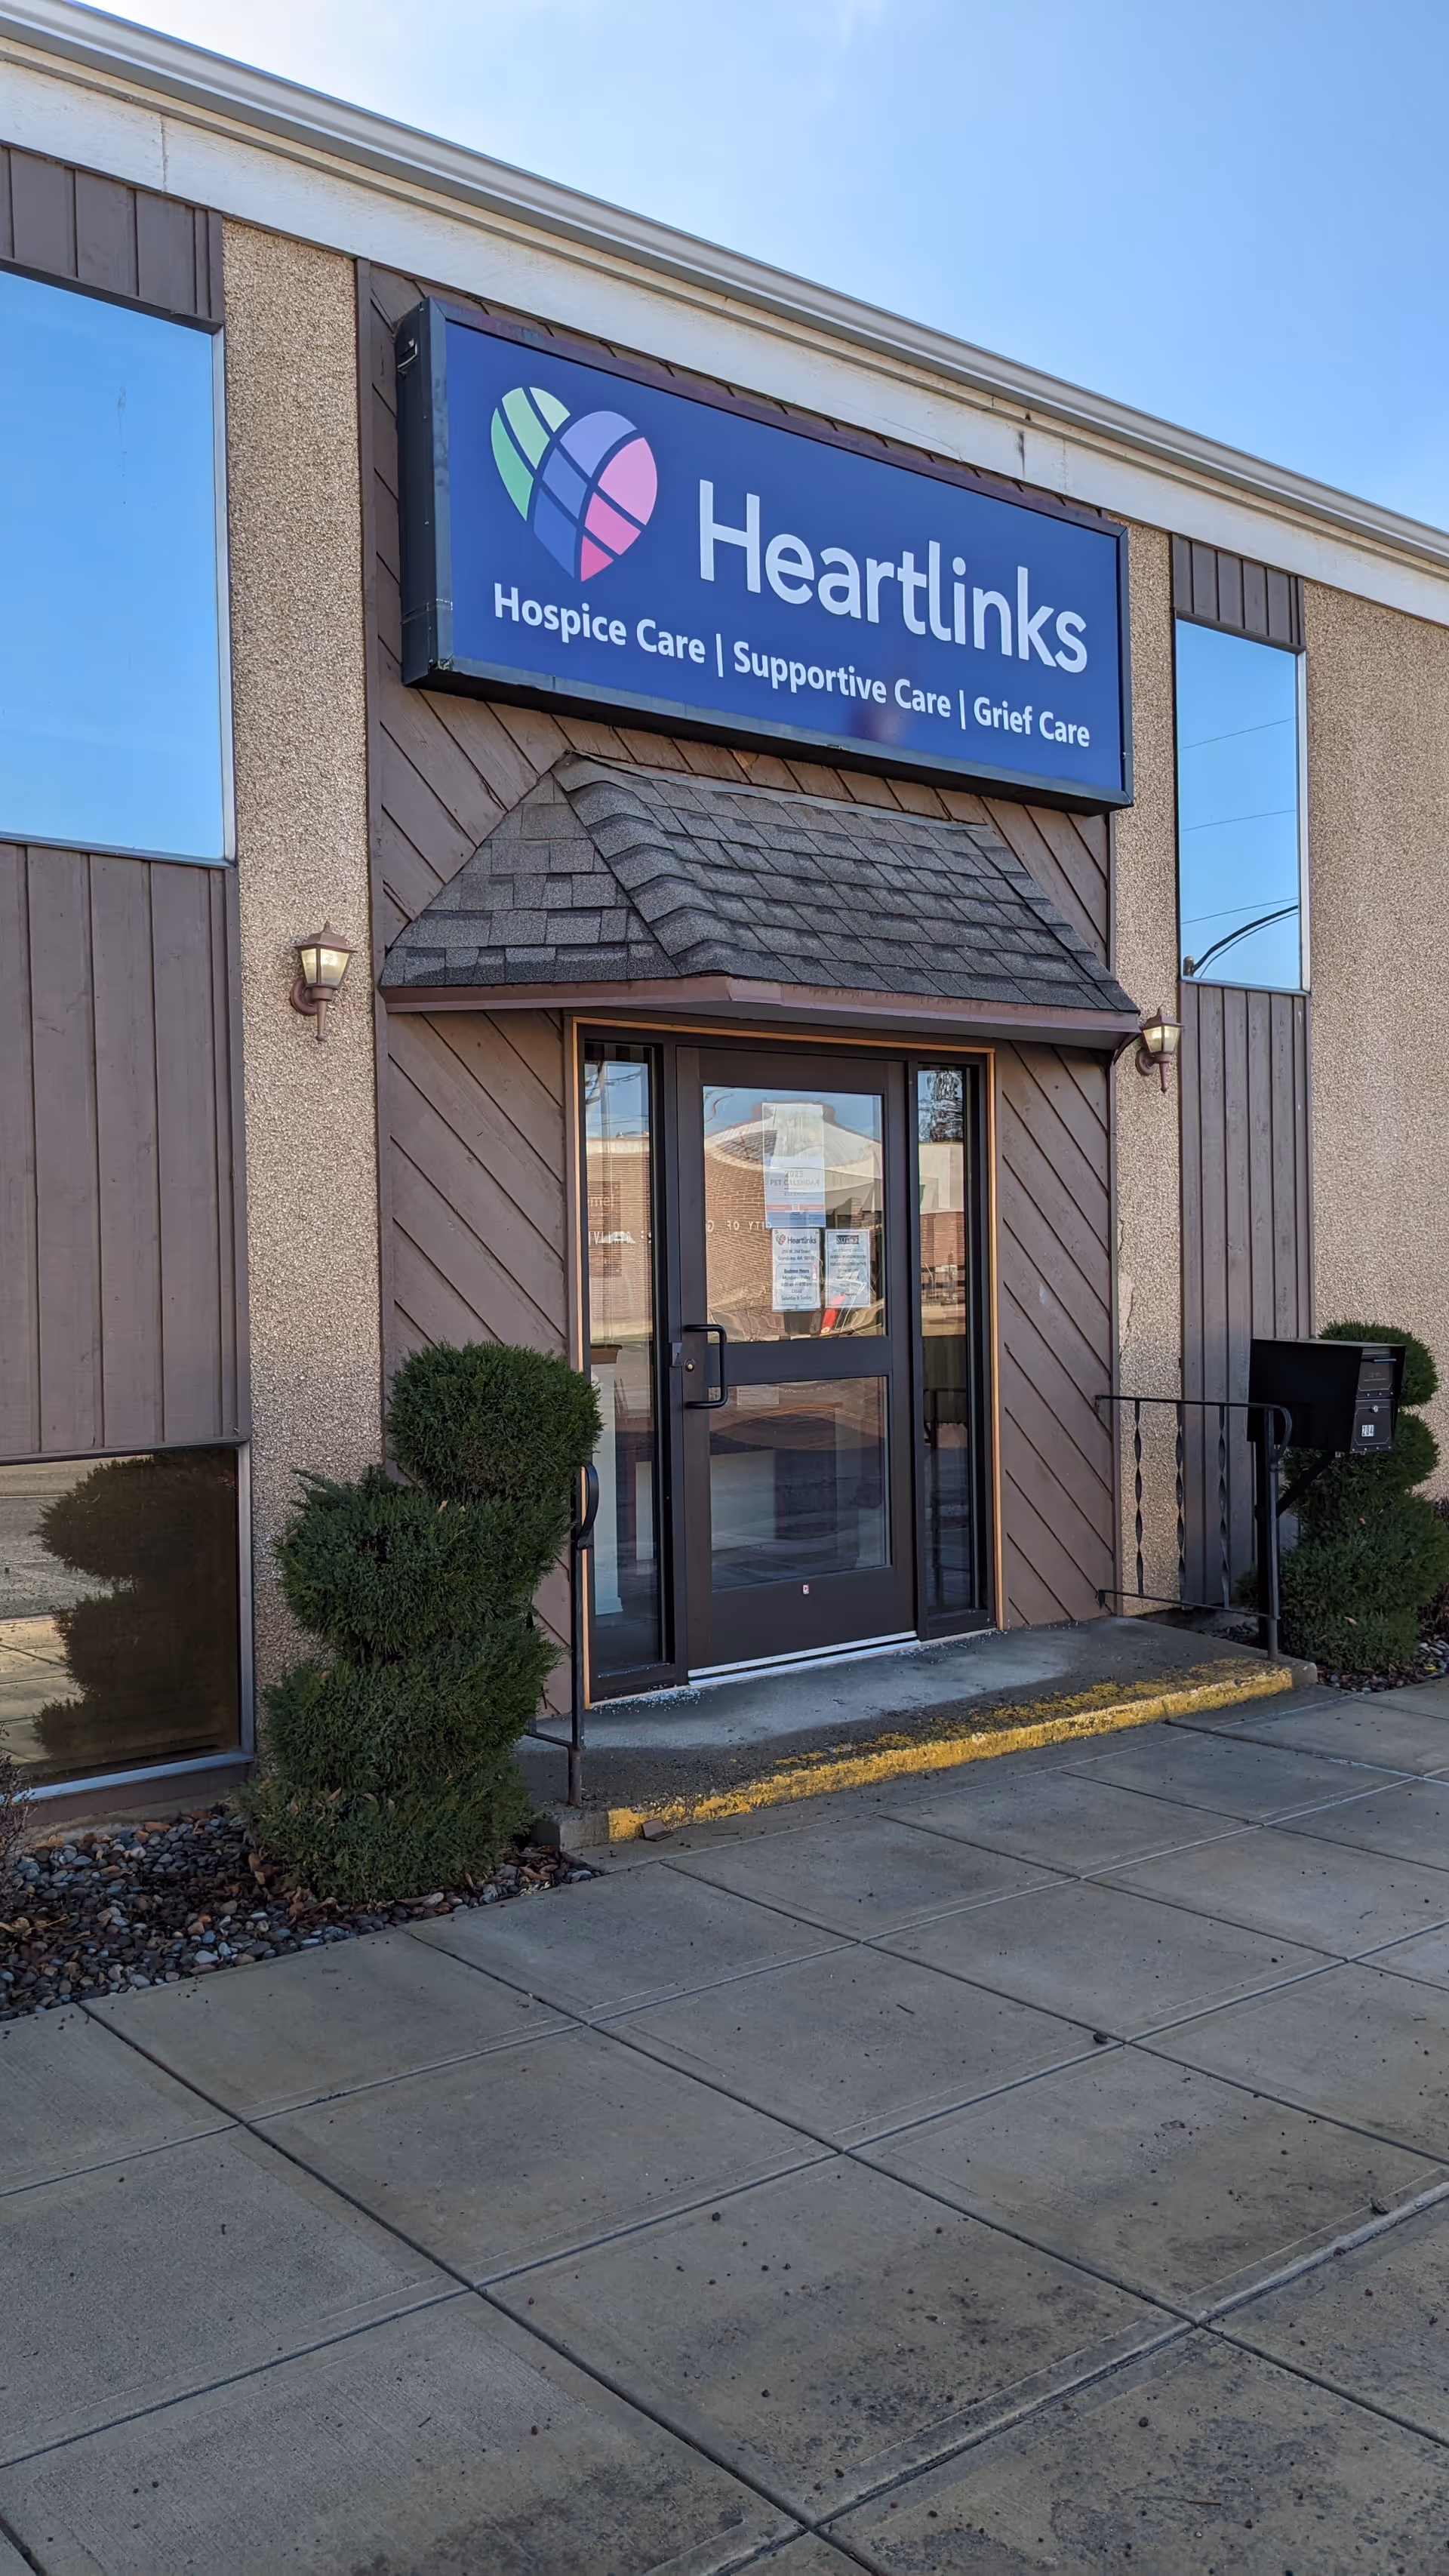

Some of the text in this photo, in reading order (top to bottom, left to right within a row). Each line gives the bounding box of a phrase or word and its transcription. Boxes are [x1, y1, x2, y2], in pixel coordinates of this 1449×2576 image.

[699, 479, 1088, 674] Heartlinks
[494, 583, 627, 646] Hospice
[636, 619, 706, 664] Care
[734, 640, 888, 704] Supportive
[894, 678, 952, 719] Care
[973, 696, 1033, 737] Grief
[1039, 710, 1091, 748] Care
[784, 1178, 820, 1186] CALENDAR
[787, 1236, 817, 1245] Heartlinks
[1362, 1426, 1374, 1436] 204
